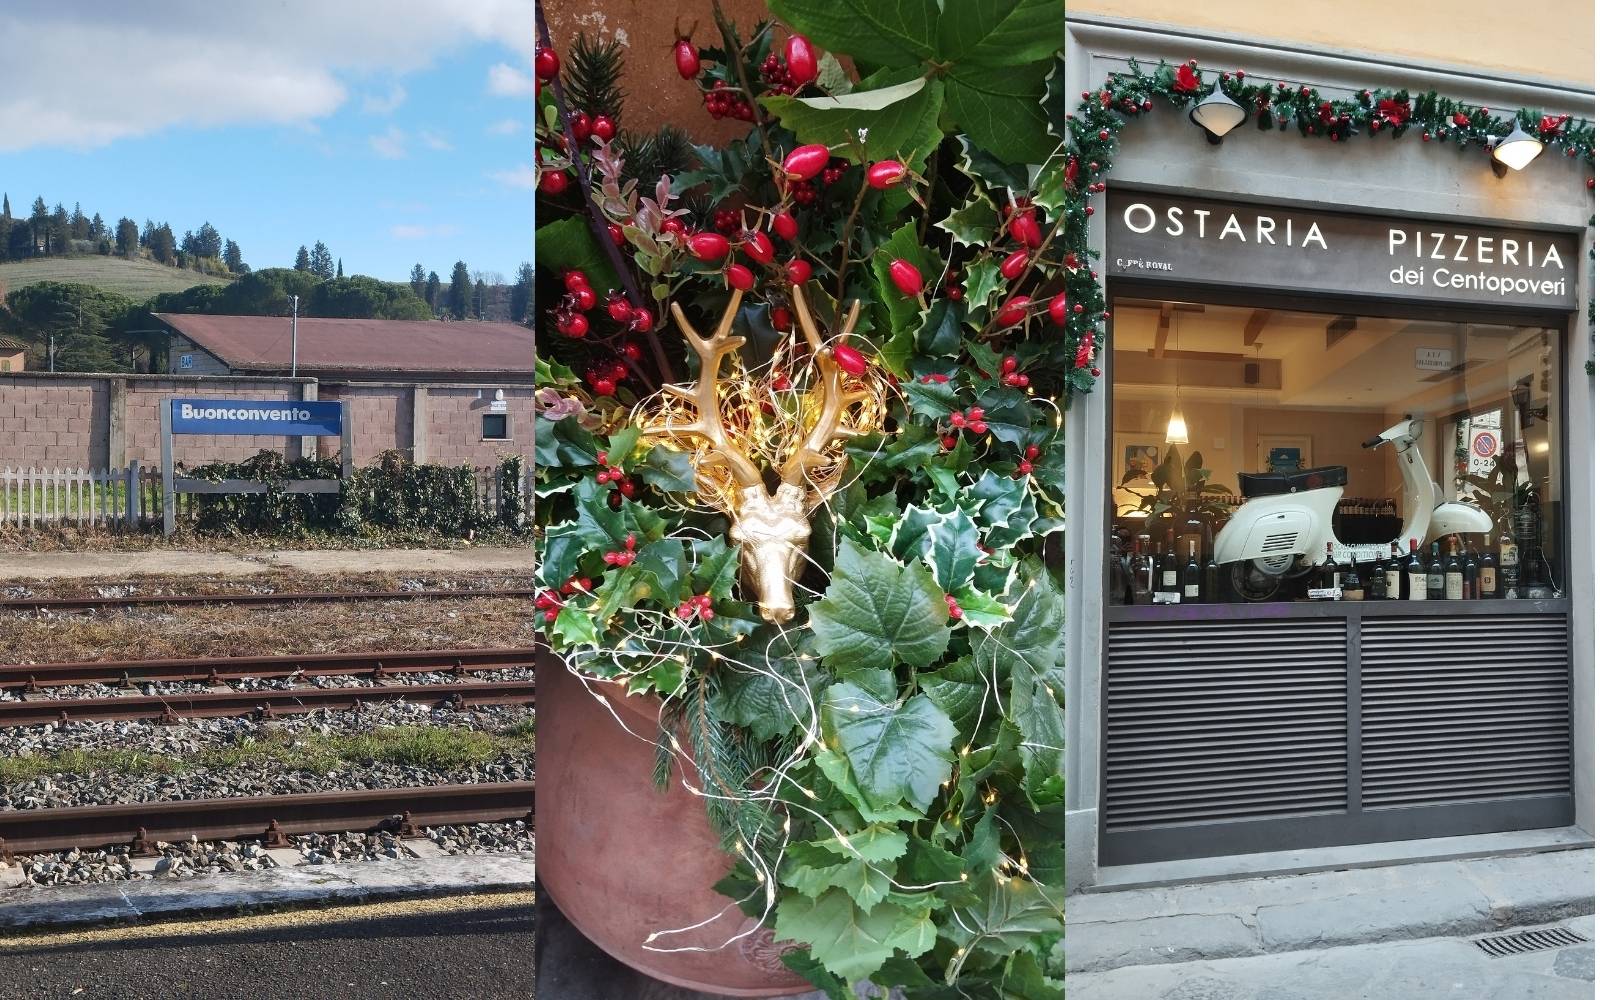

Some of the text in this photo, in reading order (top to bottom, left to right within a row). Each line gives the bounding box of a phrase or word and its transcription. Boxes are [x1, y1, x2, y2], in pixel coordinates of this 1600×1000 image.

[1123, 203, 1564, 269] OSTARIA PIZZERIA
[1389, 265, 1565, 296] dei Centopoveri
[181, 403, 311, 421] Buonconvento
